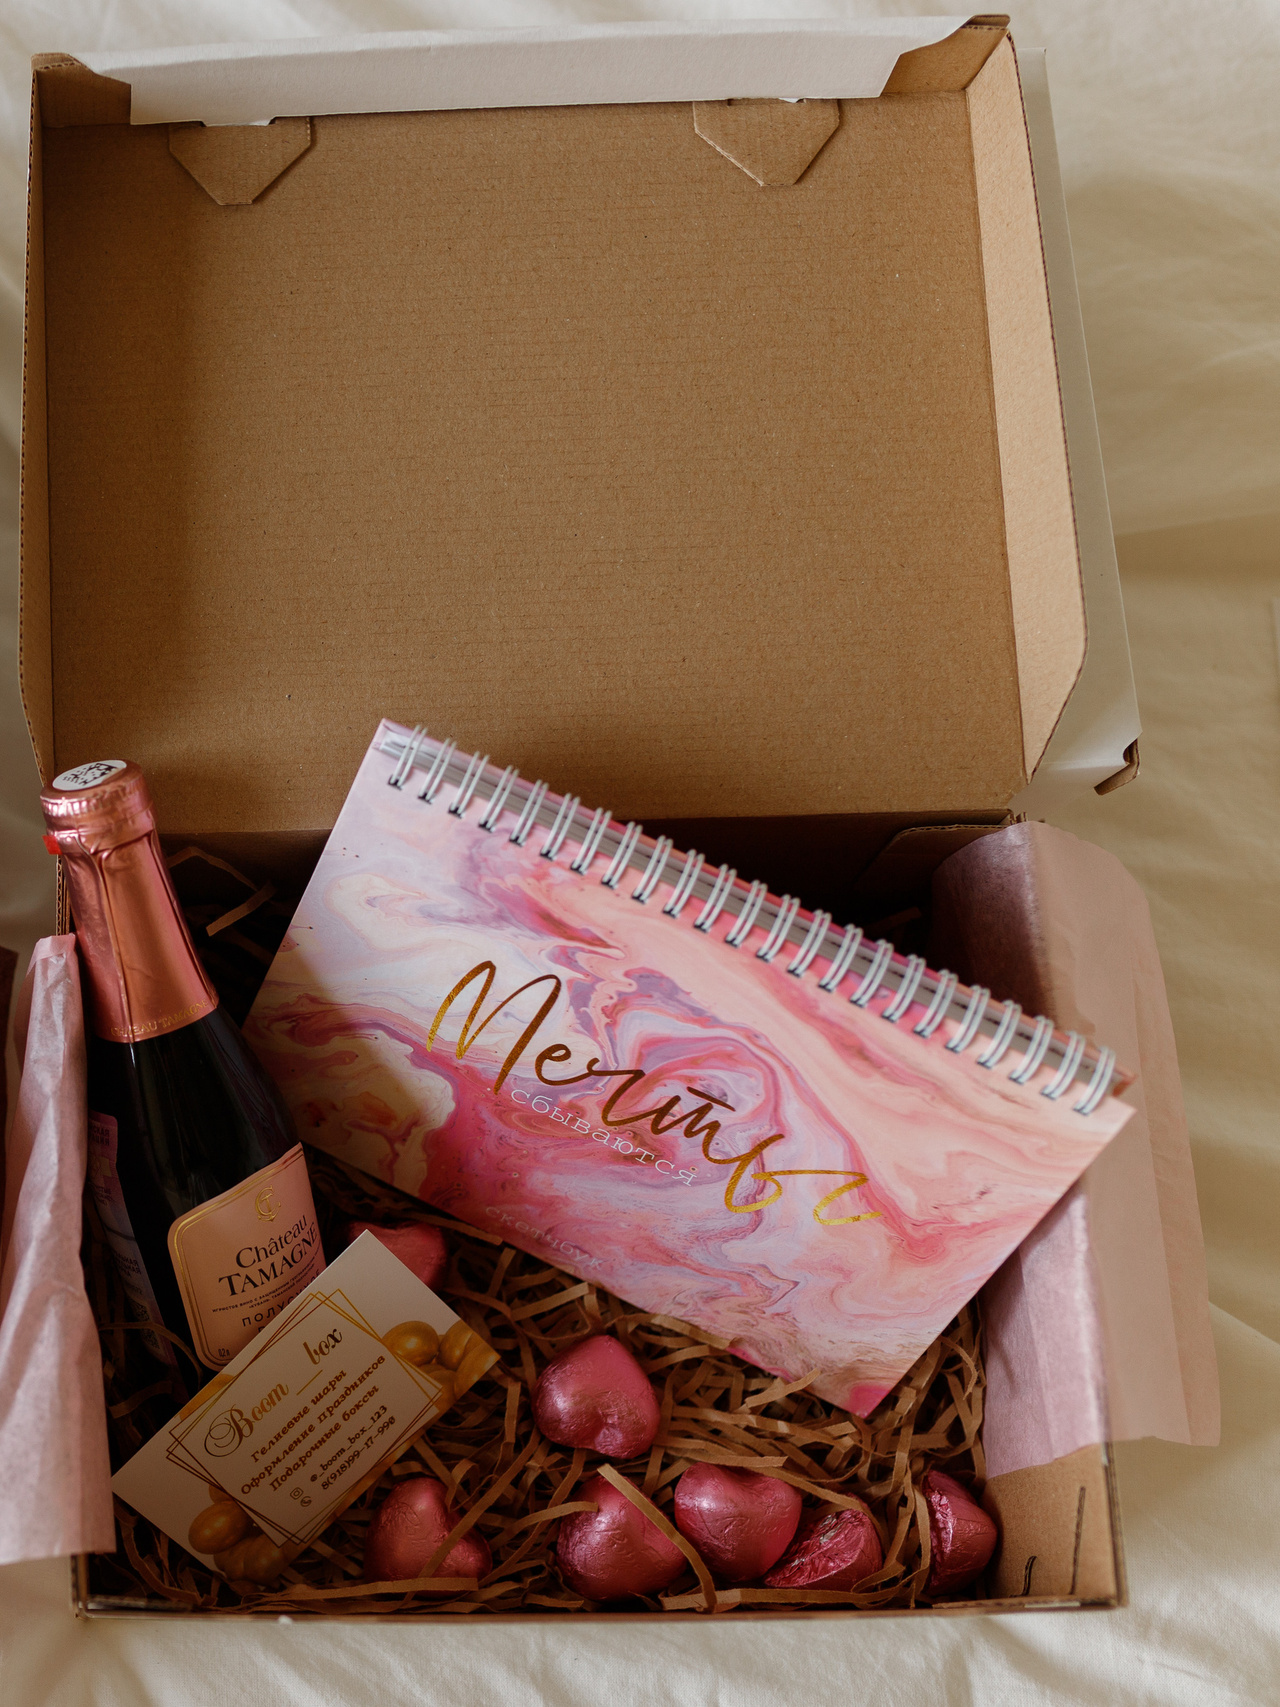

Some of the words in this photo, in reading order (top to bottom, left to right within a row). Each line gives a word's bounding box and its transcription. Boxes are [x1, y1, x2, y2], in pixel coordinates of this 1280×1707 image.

[425, 960, 882, 1226] Мечты
[218, 1222, 318, 1297] TAMAGNE
[235, 1214, 308, 1269] Château
[240, 1422, 315, 1495] Оформление
[317, 1355, 386, 1422] праздников
[251, 1398, 311, 1463] Гелиевые
[310, 1369, 347, 1405] шары
[270, 1423, 341, 1491] Подарочные
[342, 1384, 380, 1423] боксы
[310, 1405, 388, 1483] @_boom_box_123
[321, 1416, 396, 1491] 8(918)99-17-990
